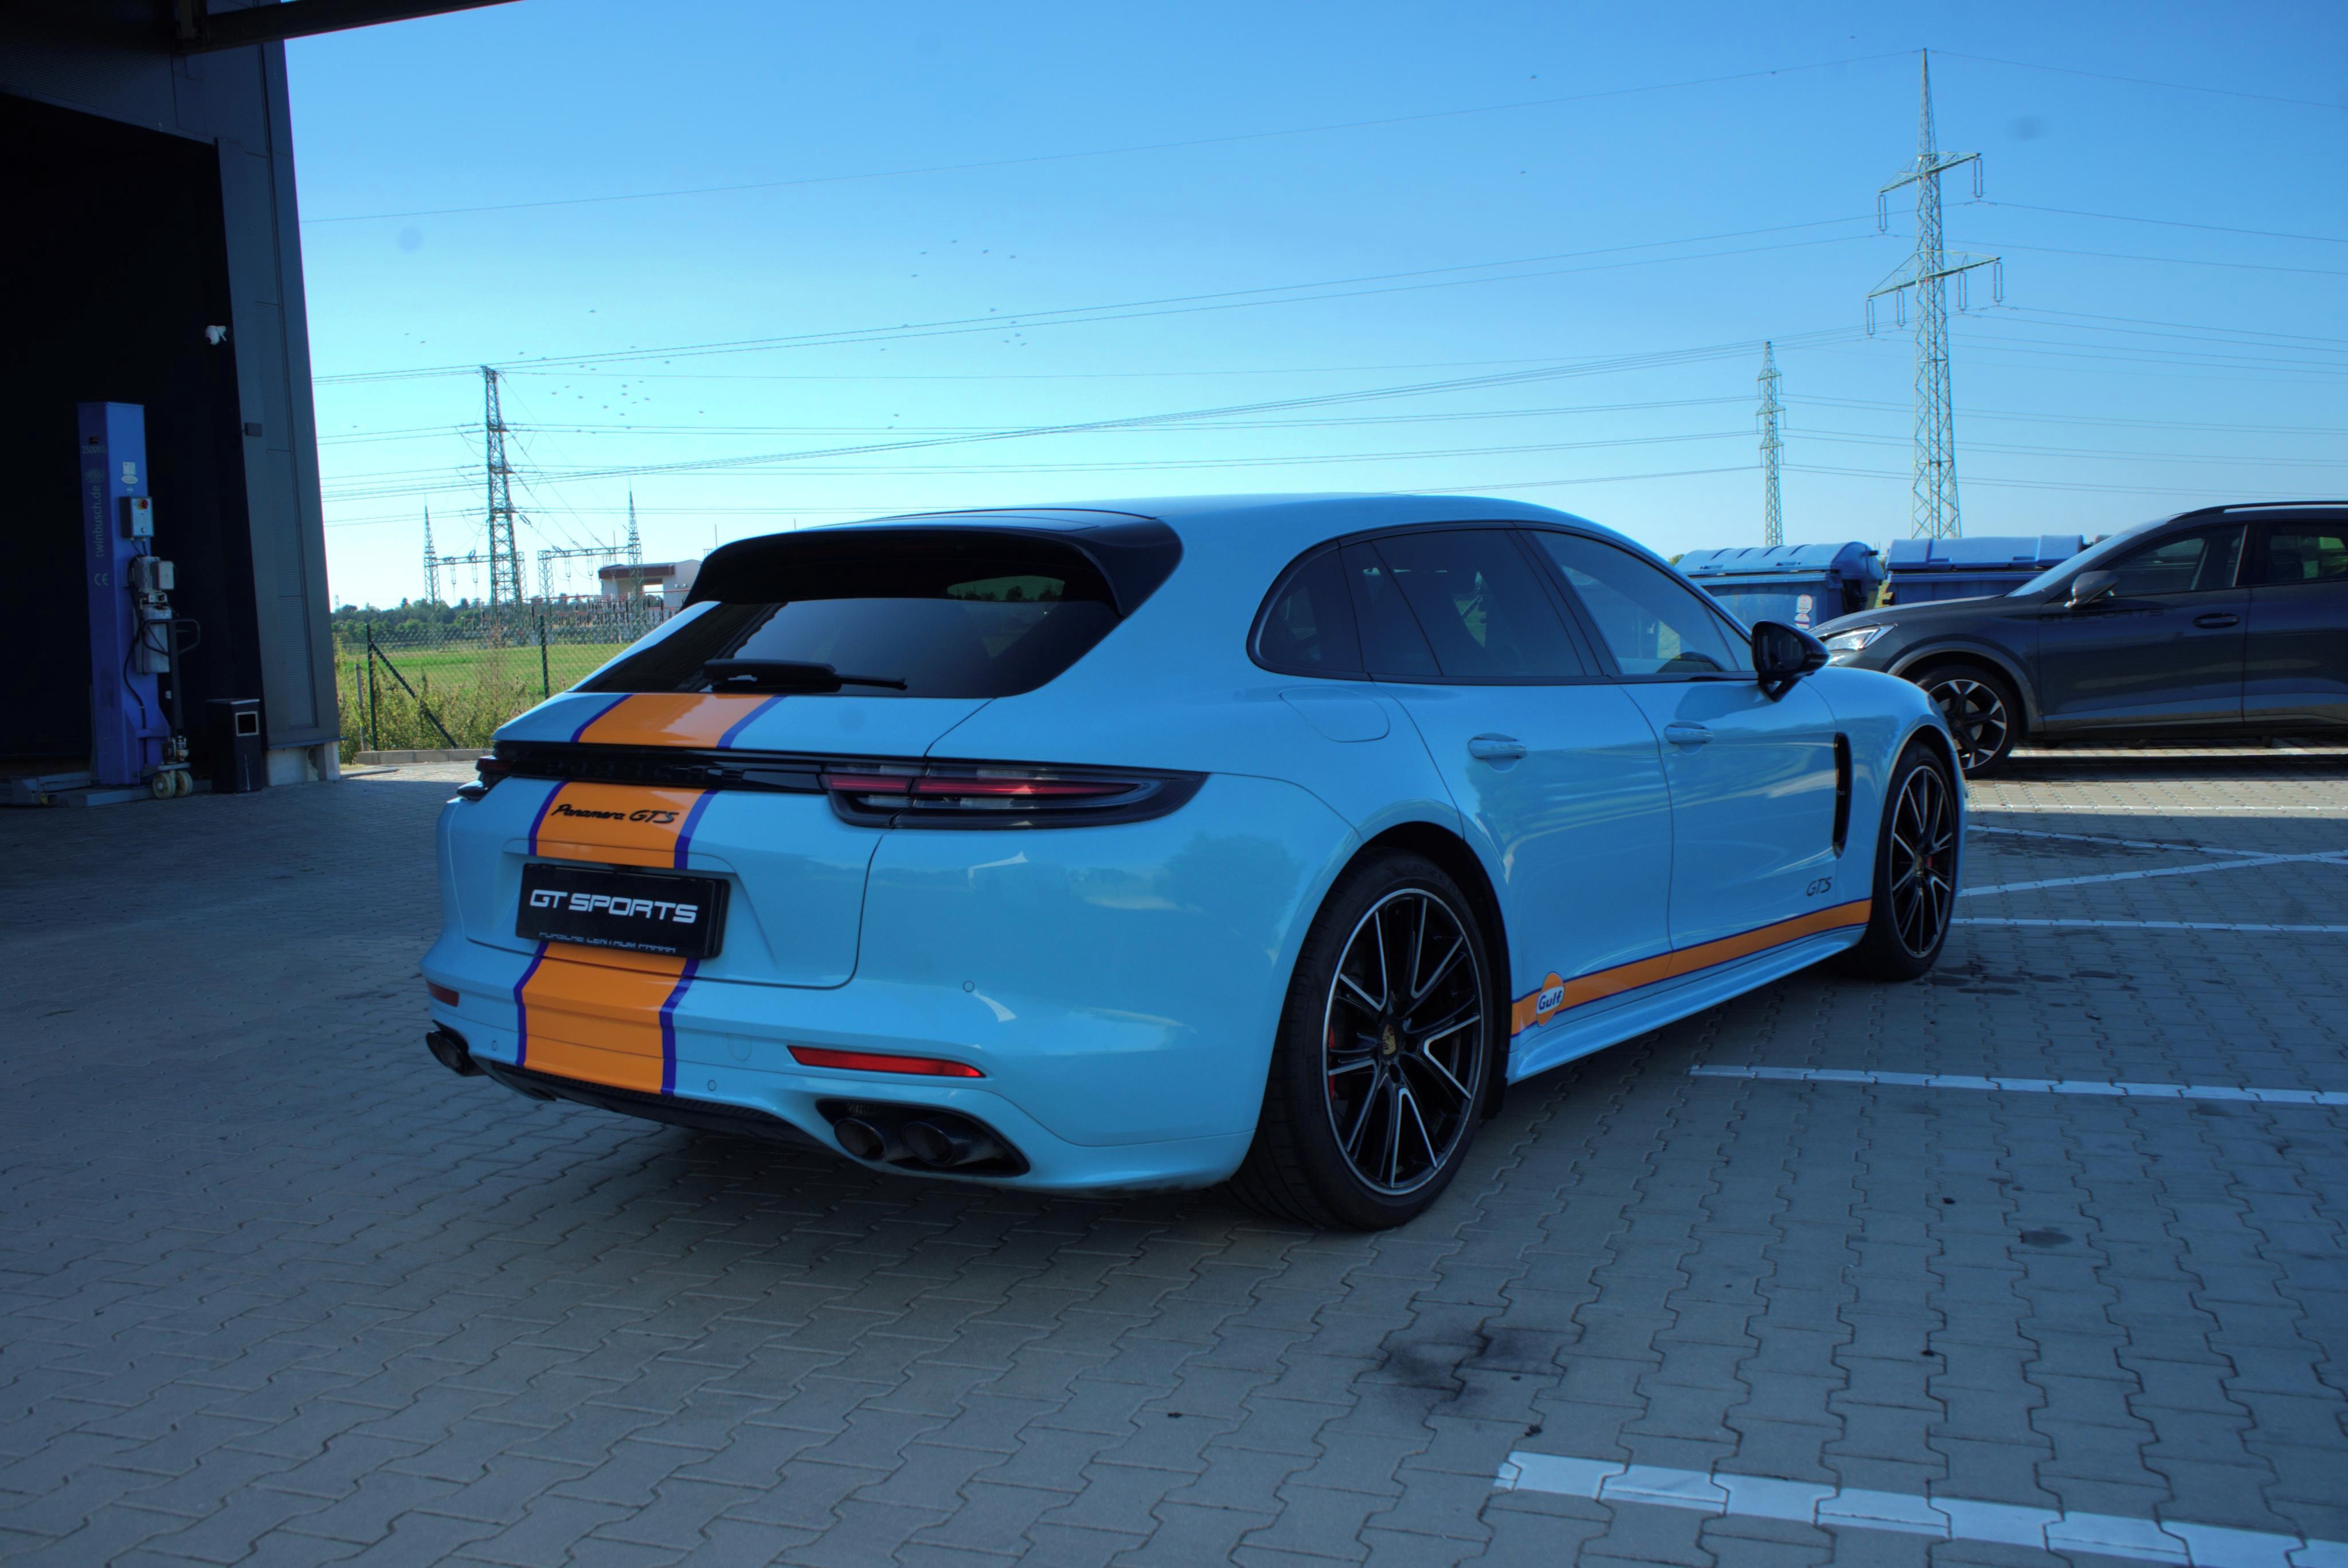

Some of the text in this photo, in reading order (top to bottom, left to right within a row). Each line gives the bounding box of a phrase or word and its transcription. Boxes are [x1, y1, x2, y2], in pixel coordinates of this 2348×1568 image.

[91, 485, 105, 558] twinbusch.de
[551, 803, 679, 824] Panamera GTS
[1807, 876, 1832, 896] GTS
[530, 889, 699, 923] GT SPORTS
[1539, 990, 1563, 1010] Gulf
